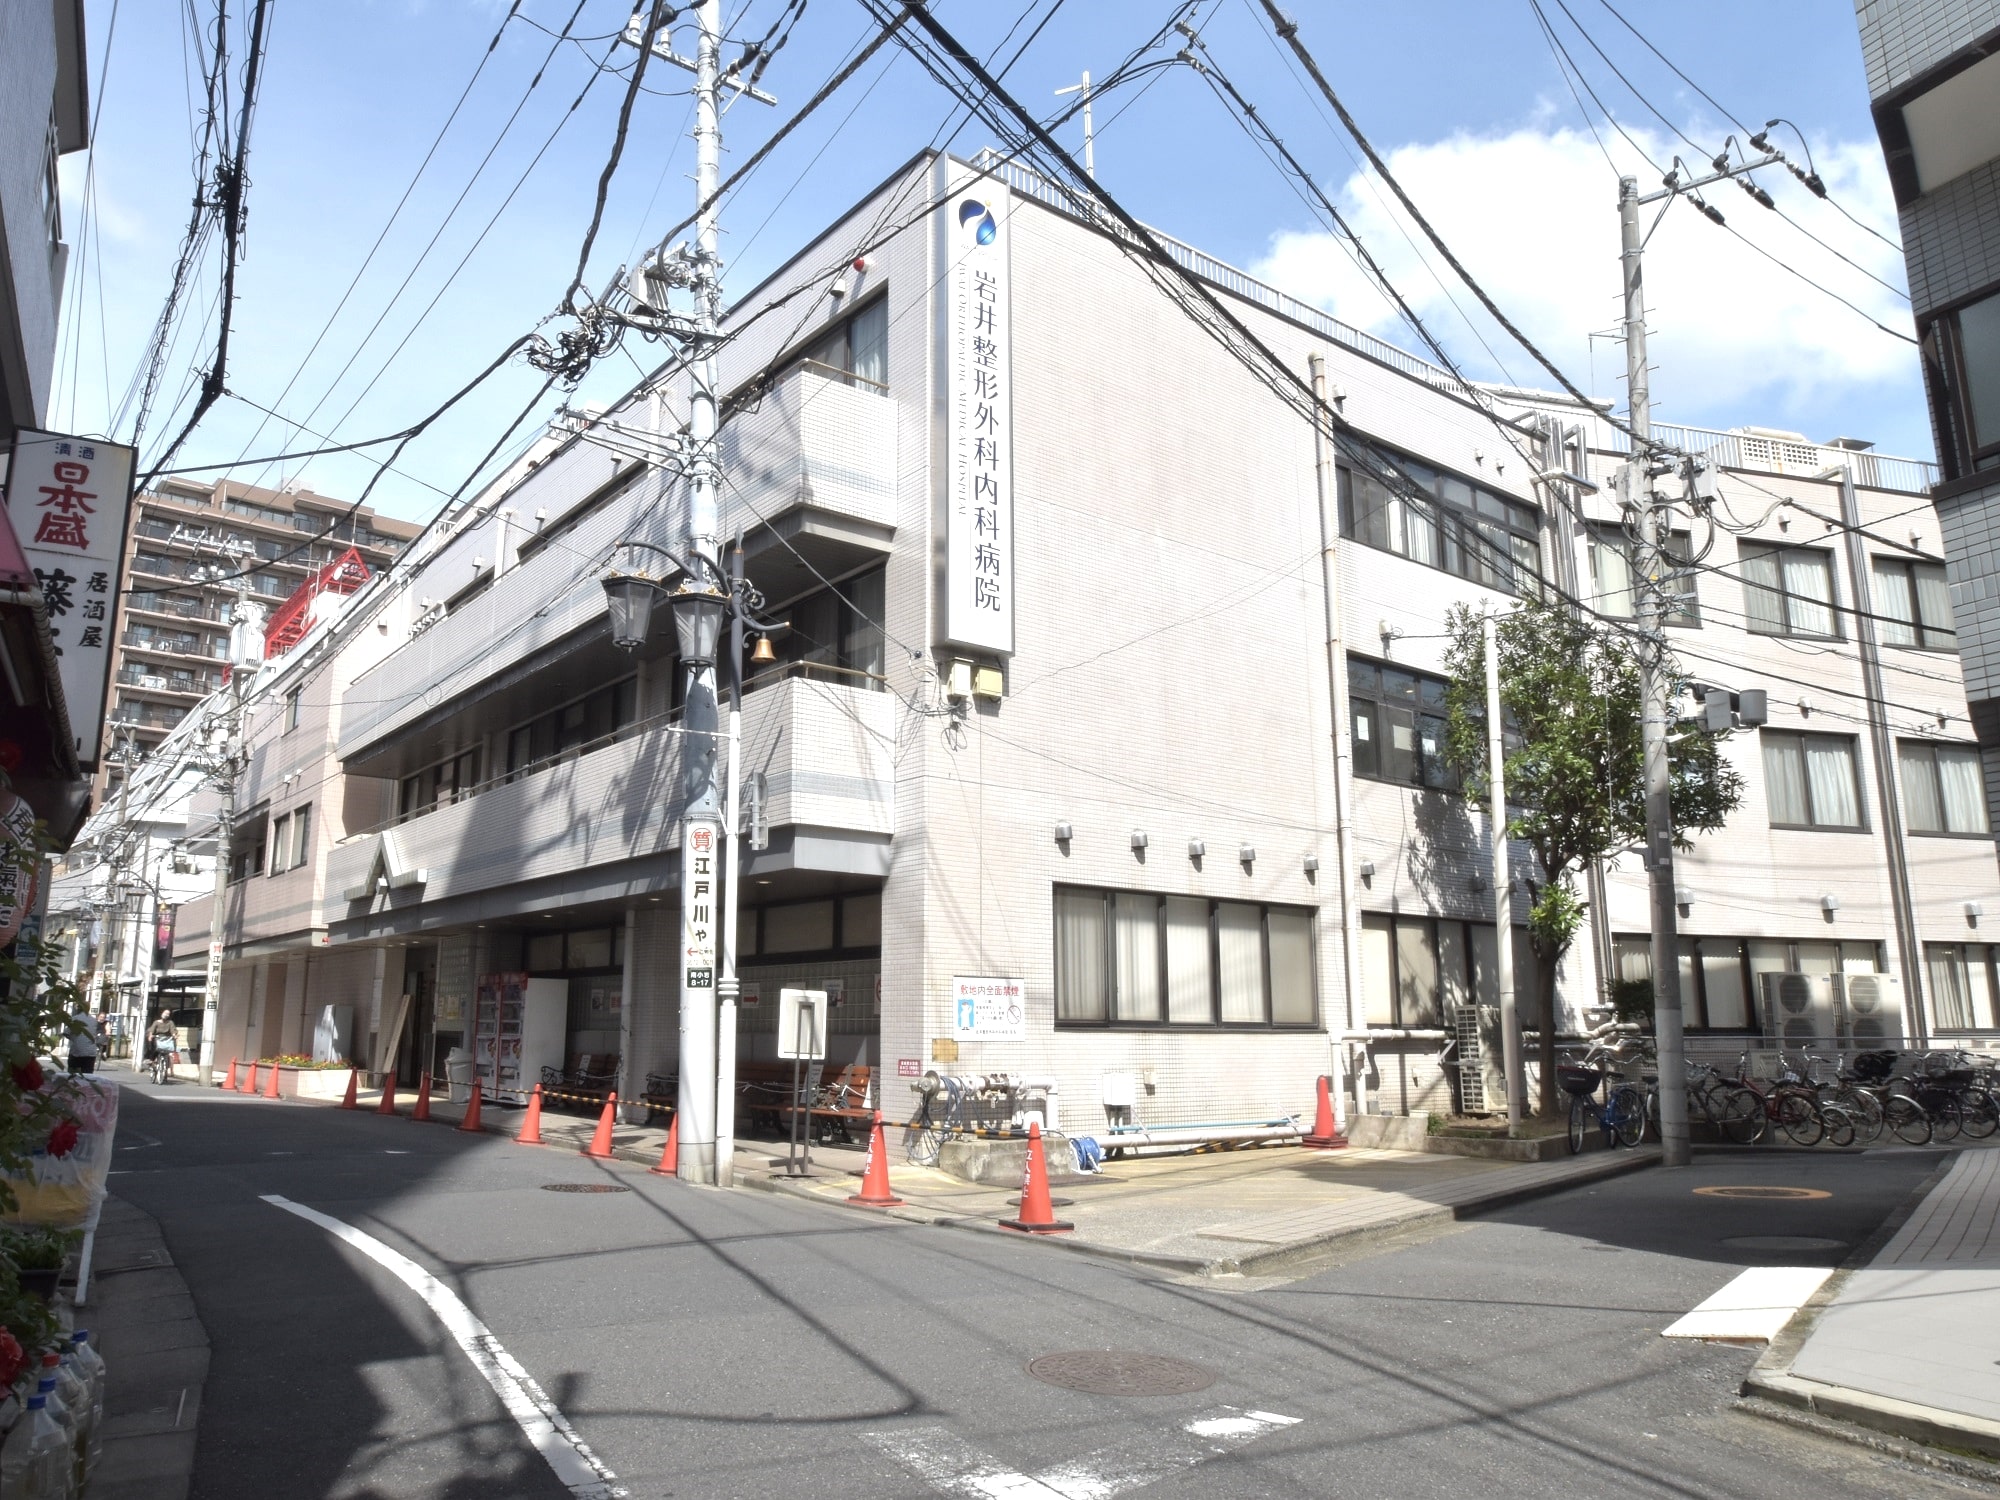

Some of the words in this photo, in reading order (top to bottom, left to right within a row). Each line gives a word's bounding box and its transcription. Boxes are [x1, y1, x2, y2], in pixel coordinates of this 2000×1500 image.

[55, 442, 95, 461] 清酒
[973, 269, 1000, 612] 岩井整形外科内科病院
[35, 461, 98, 550] 日本盛
[78, 571, 109, 649] 居酒屋
[694, 831, 711, 850] 質
[693, 857, 710, 942] 江戸川や
